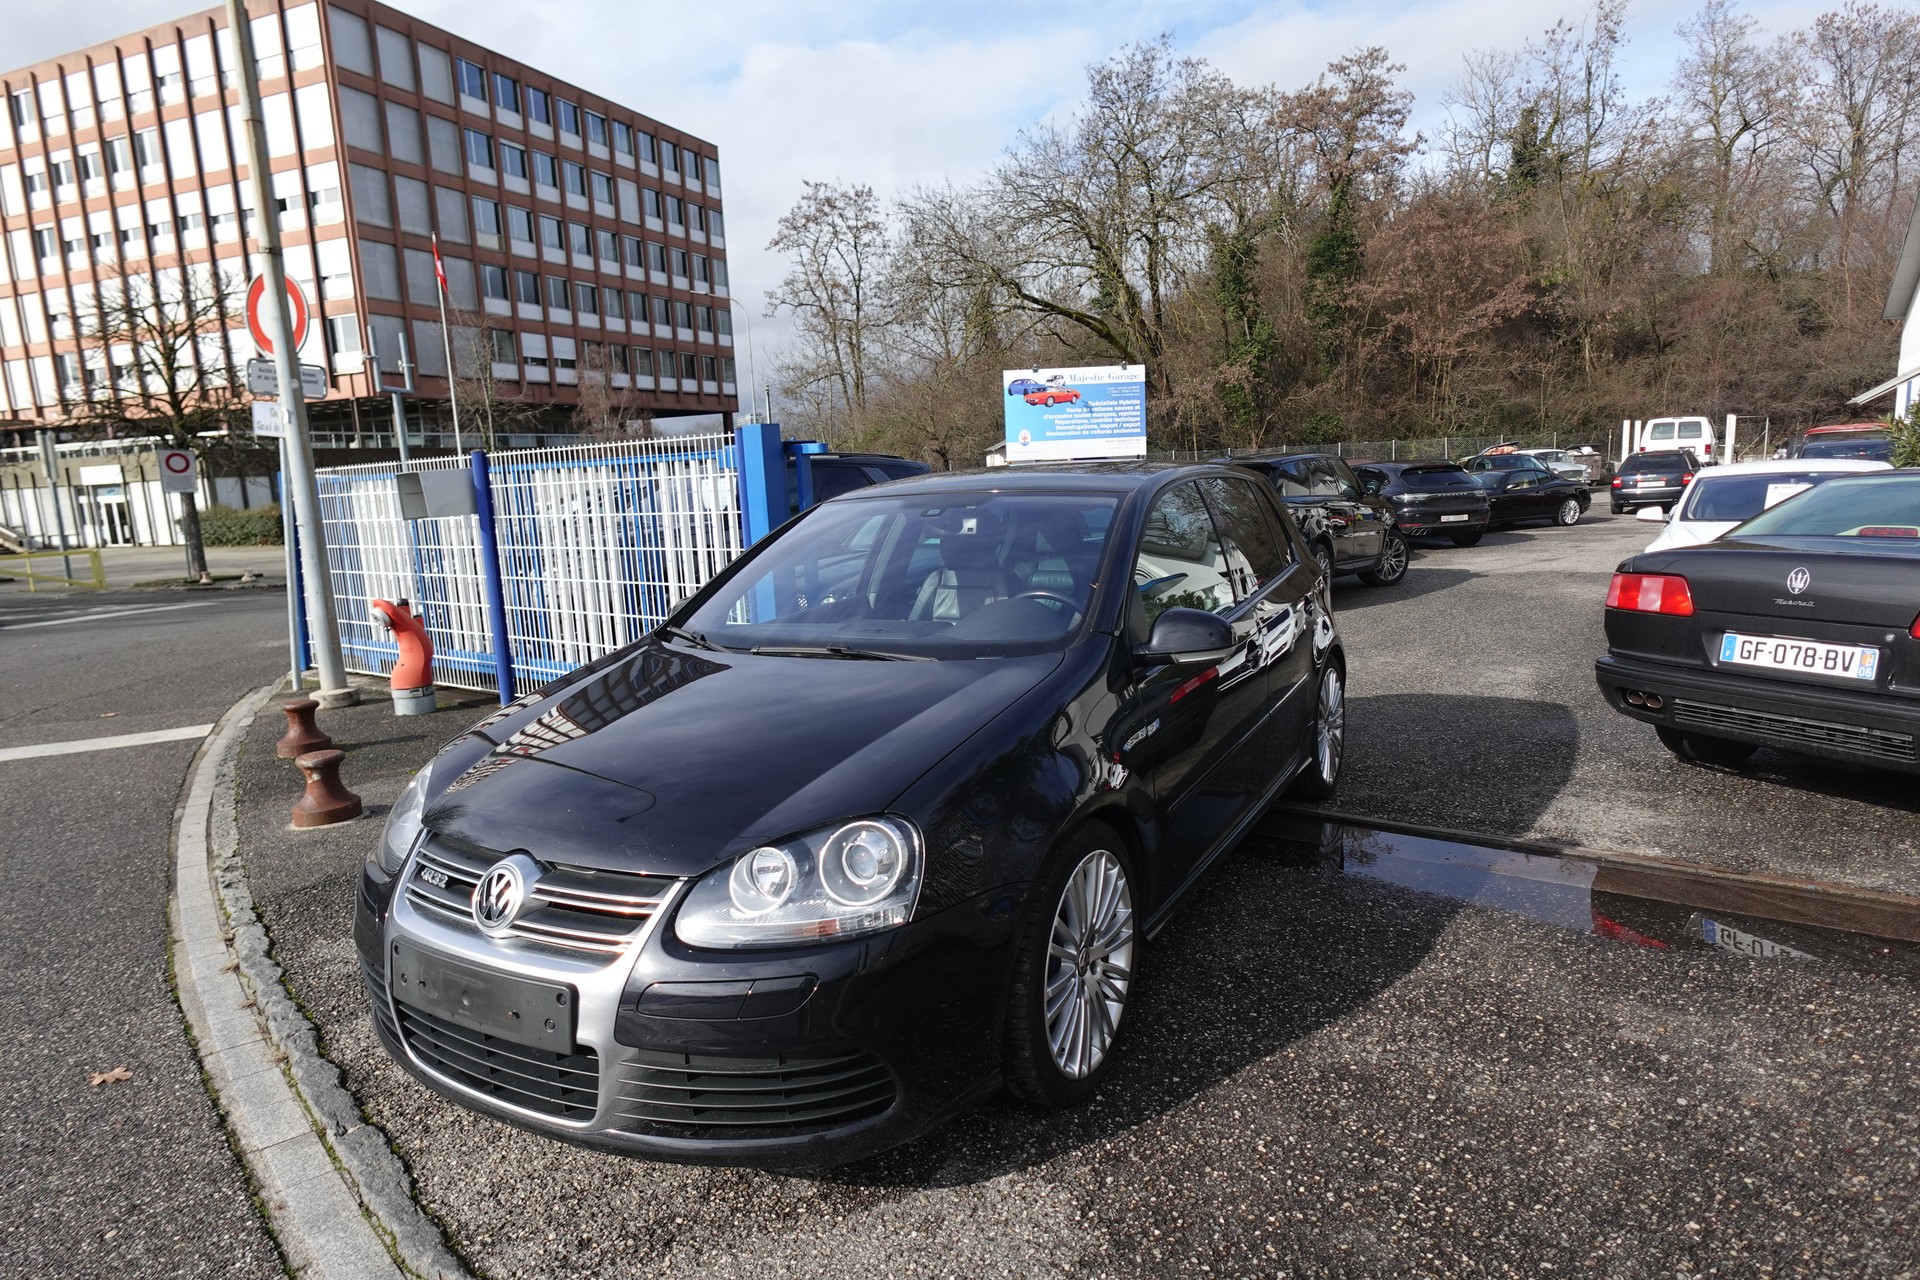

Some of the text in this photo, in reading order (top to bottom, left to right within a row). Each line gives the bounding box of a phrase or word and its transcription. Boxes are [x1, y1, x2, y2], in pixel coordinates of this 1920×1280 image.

[1069, 372, 1139, 383] Majestic Garage
[1739, 640, 1856, 673] GF-078-BV
[1859, 666, 1873, 678] 06
